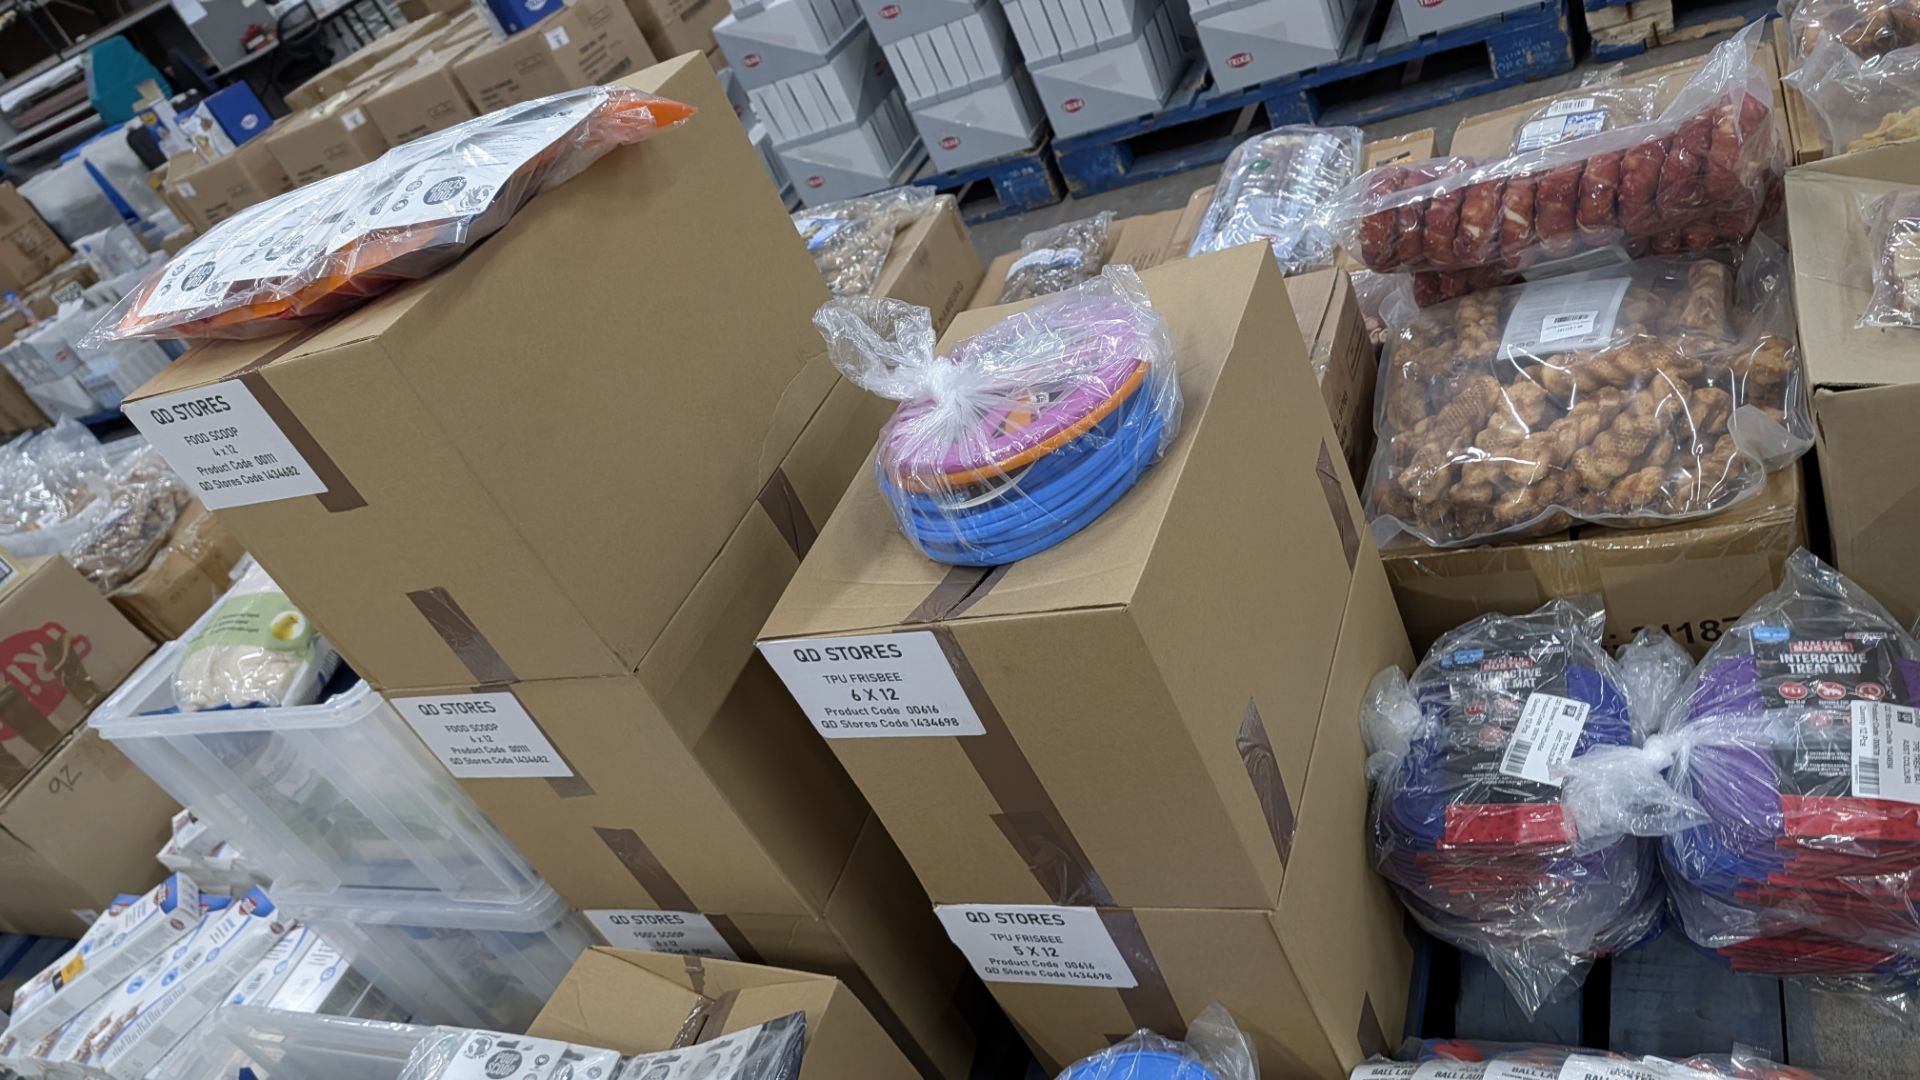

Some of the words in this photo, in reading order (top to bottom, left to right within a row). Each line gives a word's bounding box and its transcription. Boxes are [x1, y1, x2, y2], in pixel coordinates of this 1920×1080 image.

[150, 408, 175, 425] QD
[172, 395, 231, 422] STORES
[184, 431, 210, 446] FOOD
[210, 426, 239, 441] SCOOP
[212, 447, 221, 457] 4
[229, 444, 239, 455] 12
[197, 461, 229, 476] Product
[229, 458, 253, 472] Code
[254, 453, 278, 467] 00111
[199, 481, 214, 491] QD
[214, 476, 242, 490] Stores
[242, 472, 264, 485] Code
[264, 466, 300, 481] 1434682
[793, 648, 822, 663] QD
[825, 644, 903, 661] STORES
[1780, 653, 1868, 664] INTERACTIVE
[1788, 663, 1829, 674] TREAT
[1834, 663, 1862, 674] MAT
[823, 674, 848, 684] TPU
[849, 672, 903, 684] FRISBEE
[1513, 677, 1537, 689] MAT
[851, 688, 861, 701] 6
[862, 689, 879, 701] X
[879, 688, 900, 701] 12
[418, 704, 440, 716] QD
[440, 701, 496, 715] STORES
[824, 707, 869, 716] Product
[872, 706, 900, 715] Code
[906, 705, 939, 714] 00616
[445, 724, 469, 733] FOOD
[470, 723, 499, 732] SCOOP
[821, 720, 838, 729] QD
[842, 719, 877, 729] Stores
[880, 719, 909, 728] Code
[911, 717, 960, 727] 1434698
[450, 746, 483, 755] Product
[484, 745, 506, 754] Code
[466, 757, 492, 765] Stores
[493, 756, 514, 764] Code
[609, 914, 630, 925] QD
[630, 914, 685, 925] STORES
[965, 911, 990, 923] QD
[995, 912, 1066, 926] STORES
[990, 933, 1013, 942] TPU
[1014, 934, 1064, 944] FRISBEE
[1012, 945, 1023, 956] 5
[1026, 946, 1040, 957] X
[1041, 947, 1060, 958] 12
[988, 958, 1030, 967] Product
[1032, 960, 1059, 968] Code
[984, 967, 999, 975] QD
[1002, 967, 1037, 976] Stores
[1039, 970, 1066, 978] Code
[1371, 1067, 1393, 1076] BALL
[1435, 1071, 1457, 1079] BALL
[1511, 1066, 1536, 1076] BALL
